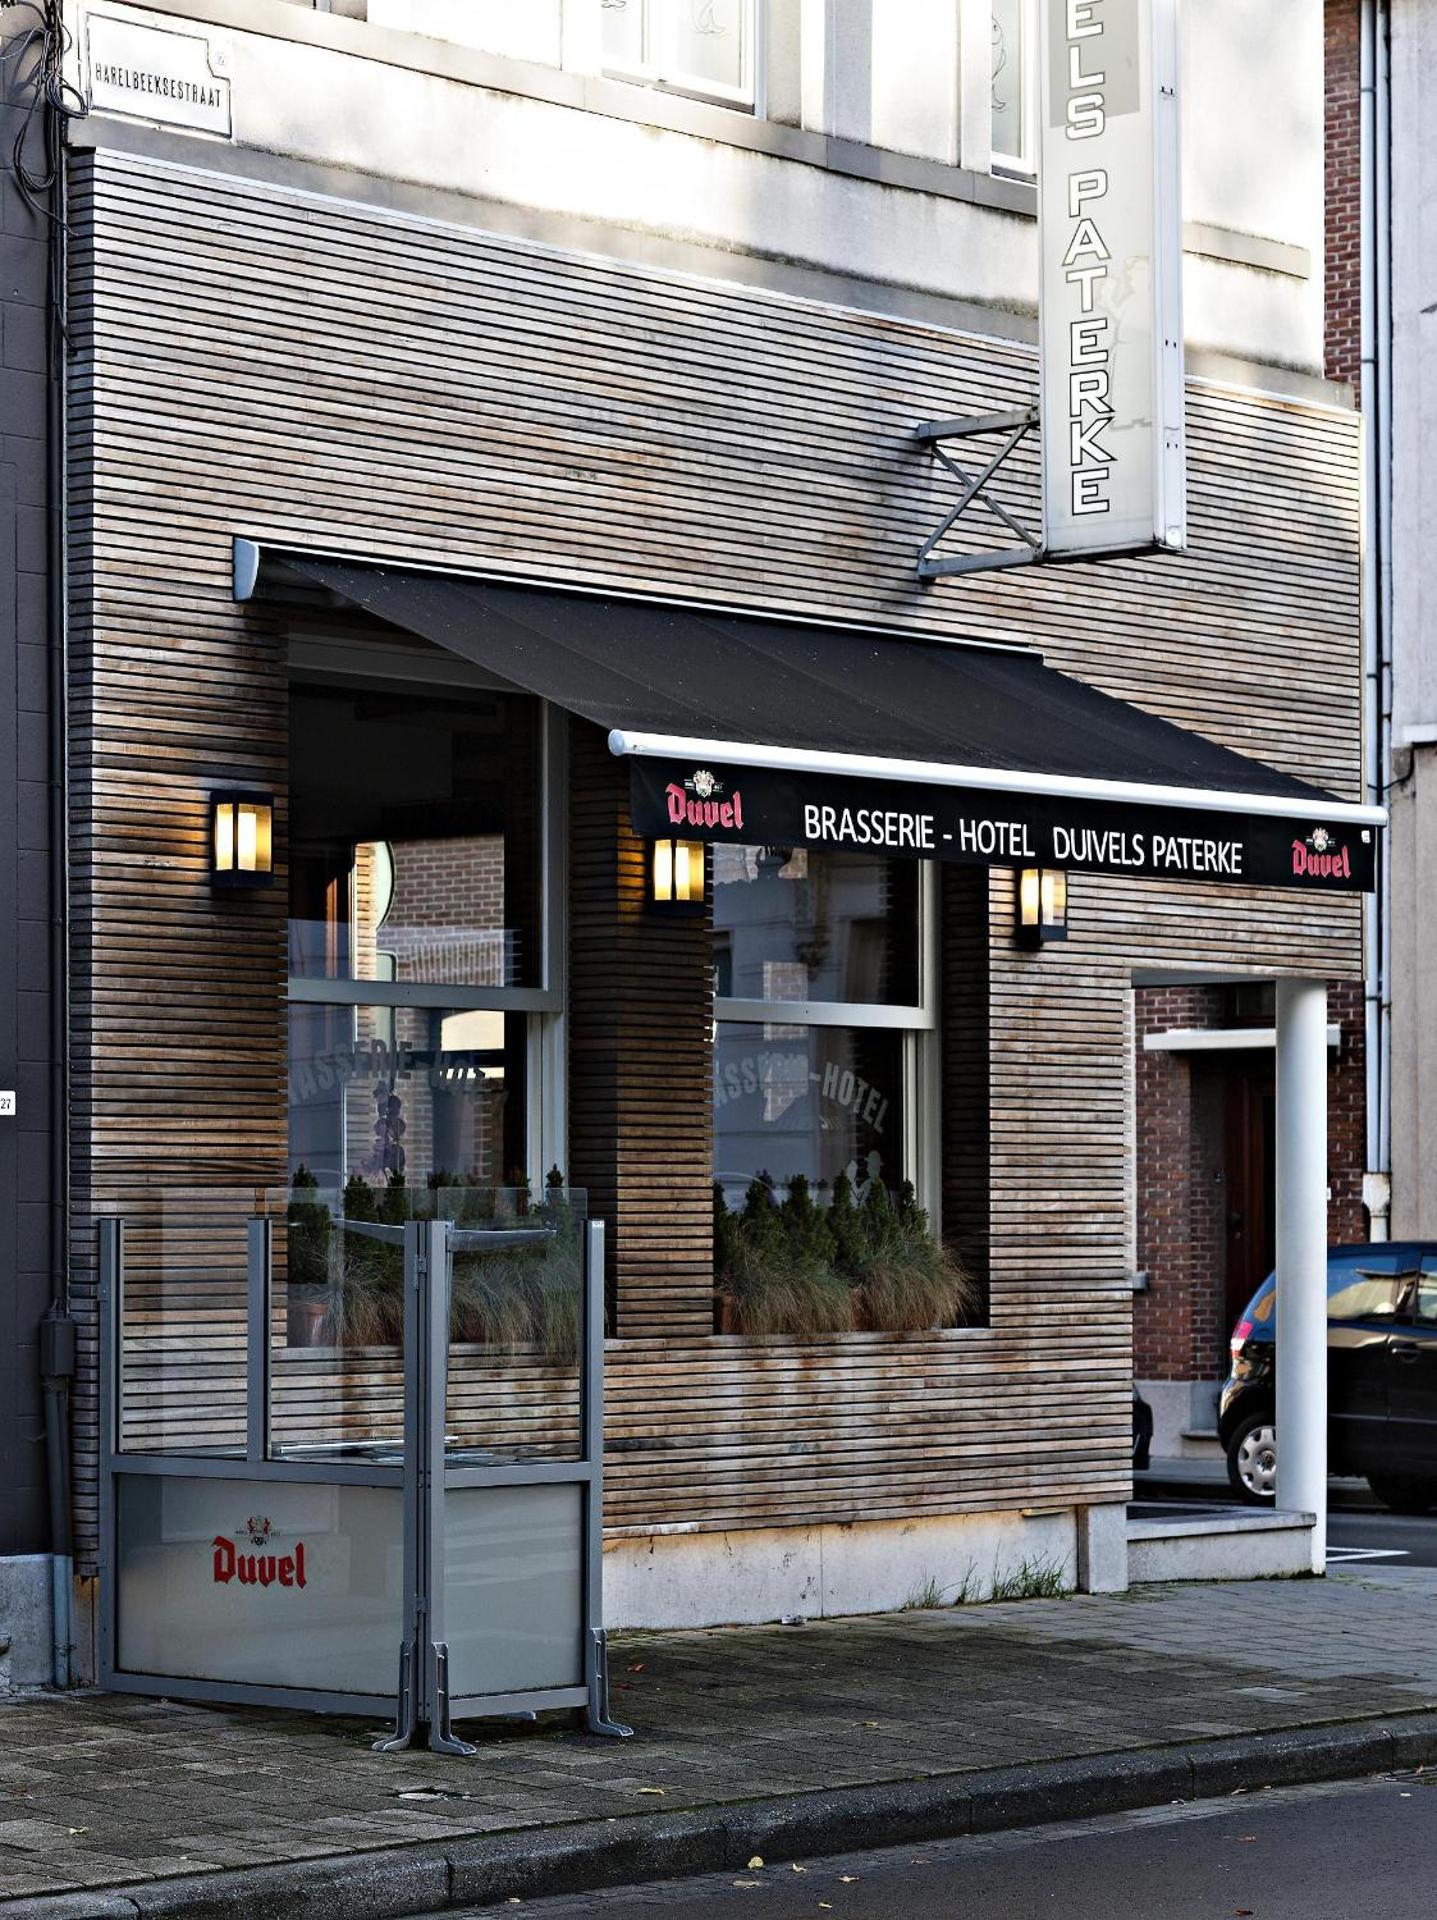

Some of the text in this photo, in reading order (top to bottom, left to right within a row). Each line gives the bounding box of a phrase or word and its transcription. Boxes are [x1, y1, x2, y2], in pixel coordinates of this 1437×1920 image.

[95, 62, 221, 108] HARELBEEKSESTRAAT
[1062, 168, 1118, 516] PATERKE
[665, 782, 744, 829] Duvel
[804, 804, 935, 849] BRASSERIE
[959, 818, 1036, 857] HOTEL
[1053, 826, 1145, 867] DUIVELS
[1153, 835, 1243, 875] PATERKE
[1291, 839, 1351, 879] Duvel
[211, 1535, 307, 1590] Duvel
